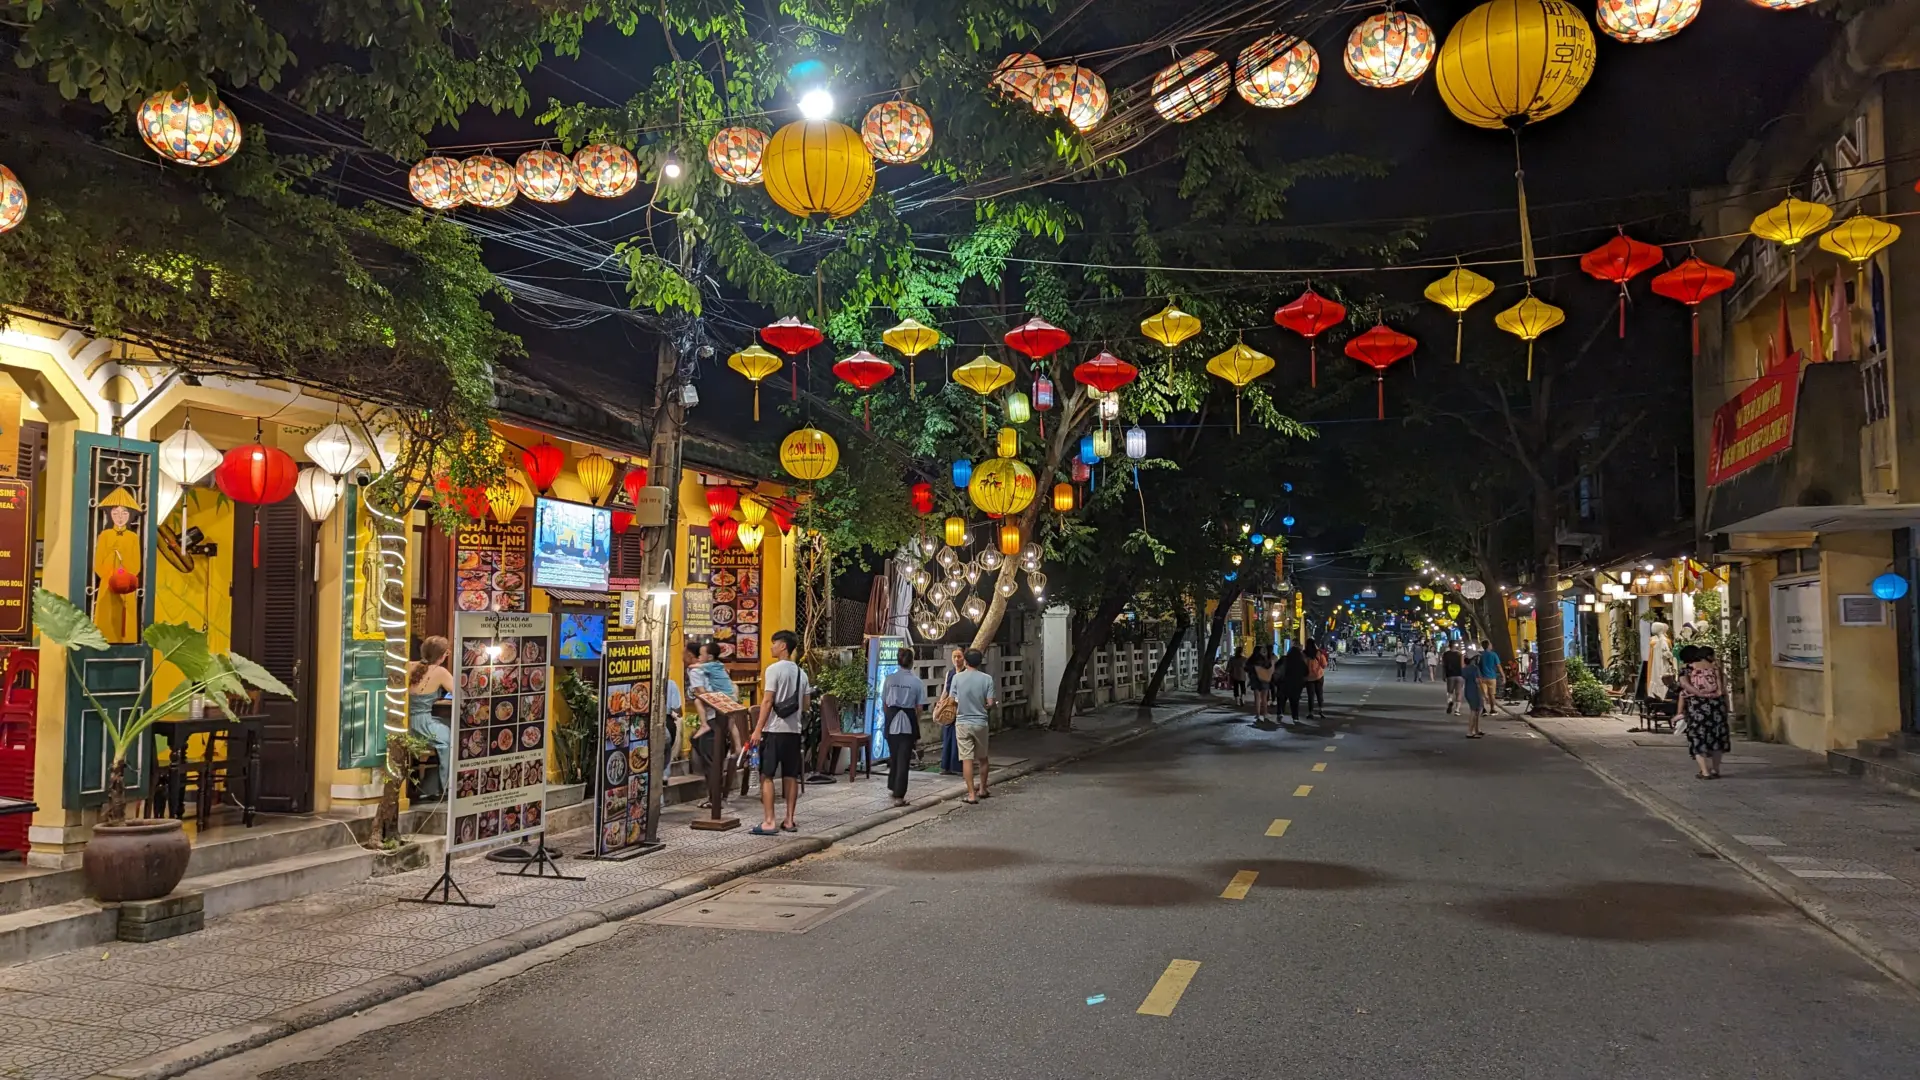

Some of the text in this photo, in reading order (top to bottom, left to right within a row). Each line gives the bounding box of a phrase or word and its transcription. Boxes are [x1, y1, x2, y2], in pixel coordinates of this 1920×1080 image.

[1556, 19, 1585, 41] Home
[1545, 69, 1561, 82] 44
[6, 599, 21, 607] RICE
[609, 644, 650, 657] NHÀ HÀNG
[608, 659, 650, 674] CƠM LINH
